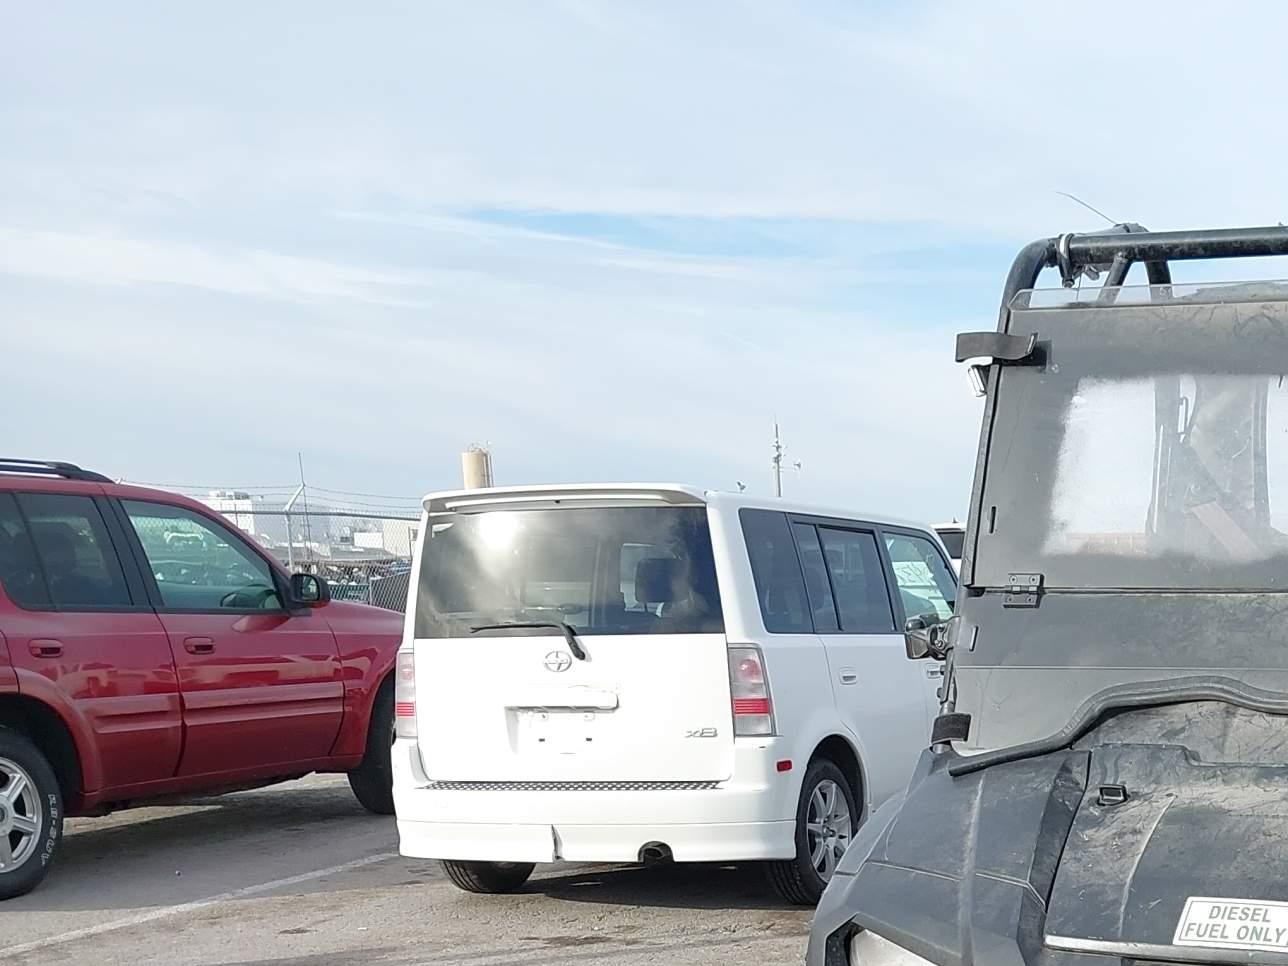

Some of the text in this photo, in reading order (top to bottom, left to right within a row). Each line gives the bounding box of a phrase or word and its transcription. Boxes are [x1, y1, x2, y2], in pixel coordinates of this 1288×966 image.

[1207, 904, 1272, 923] DIESEL
[1184, 921, 1288, 945] FUEL ONLY
